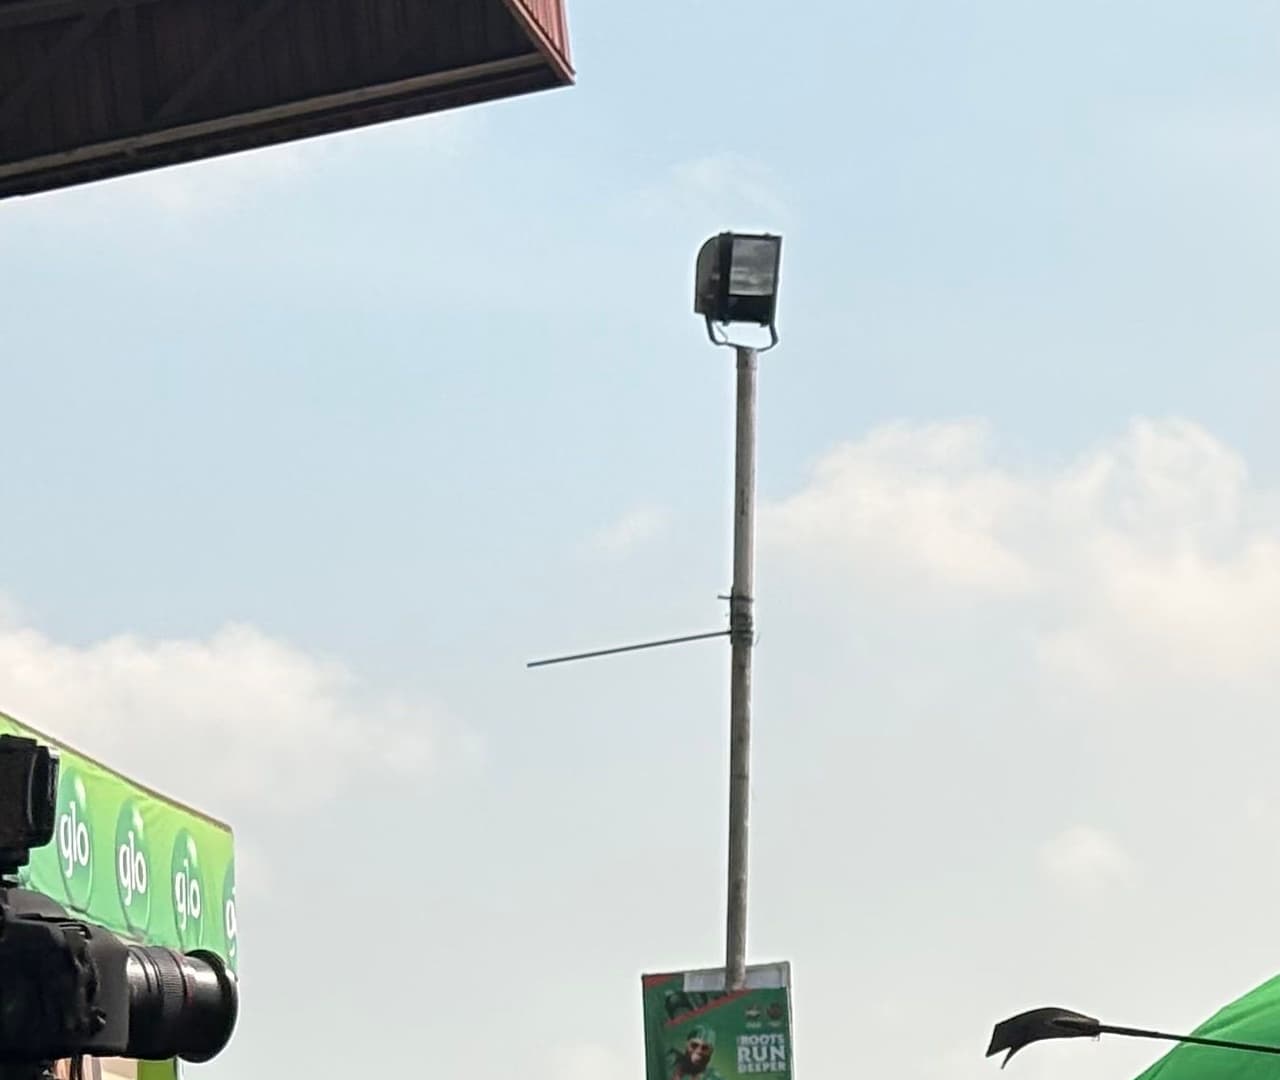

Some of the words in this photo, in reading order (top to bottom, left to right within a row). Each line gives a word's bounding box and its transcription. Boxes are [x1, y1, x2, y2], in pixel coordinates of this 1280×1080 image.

[59, 800, 90, 879] glo
[118, 830, 147, 906] glo
[174, 858, 201, 930] glo
[737, 1045, 785, 1062] RUN
